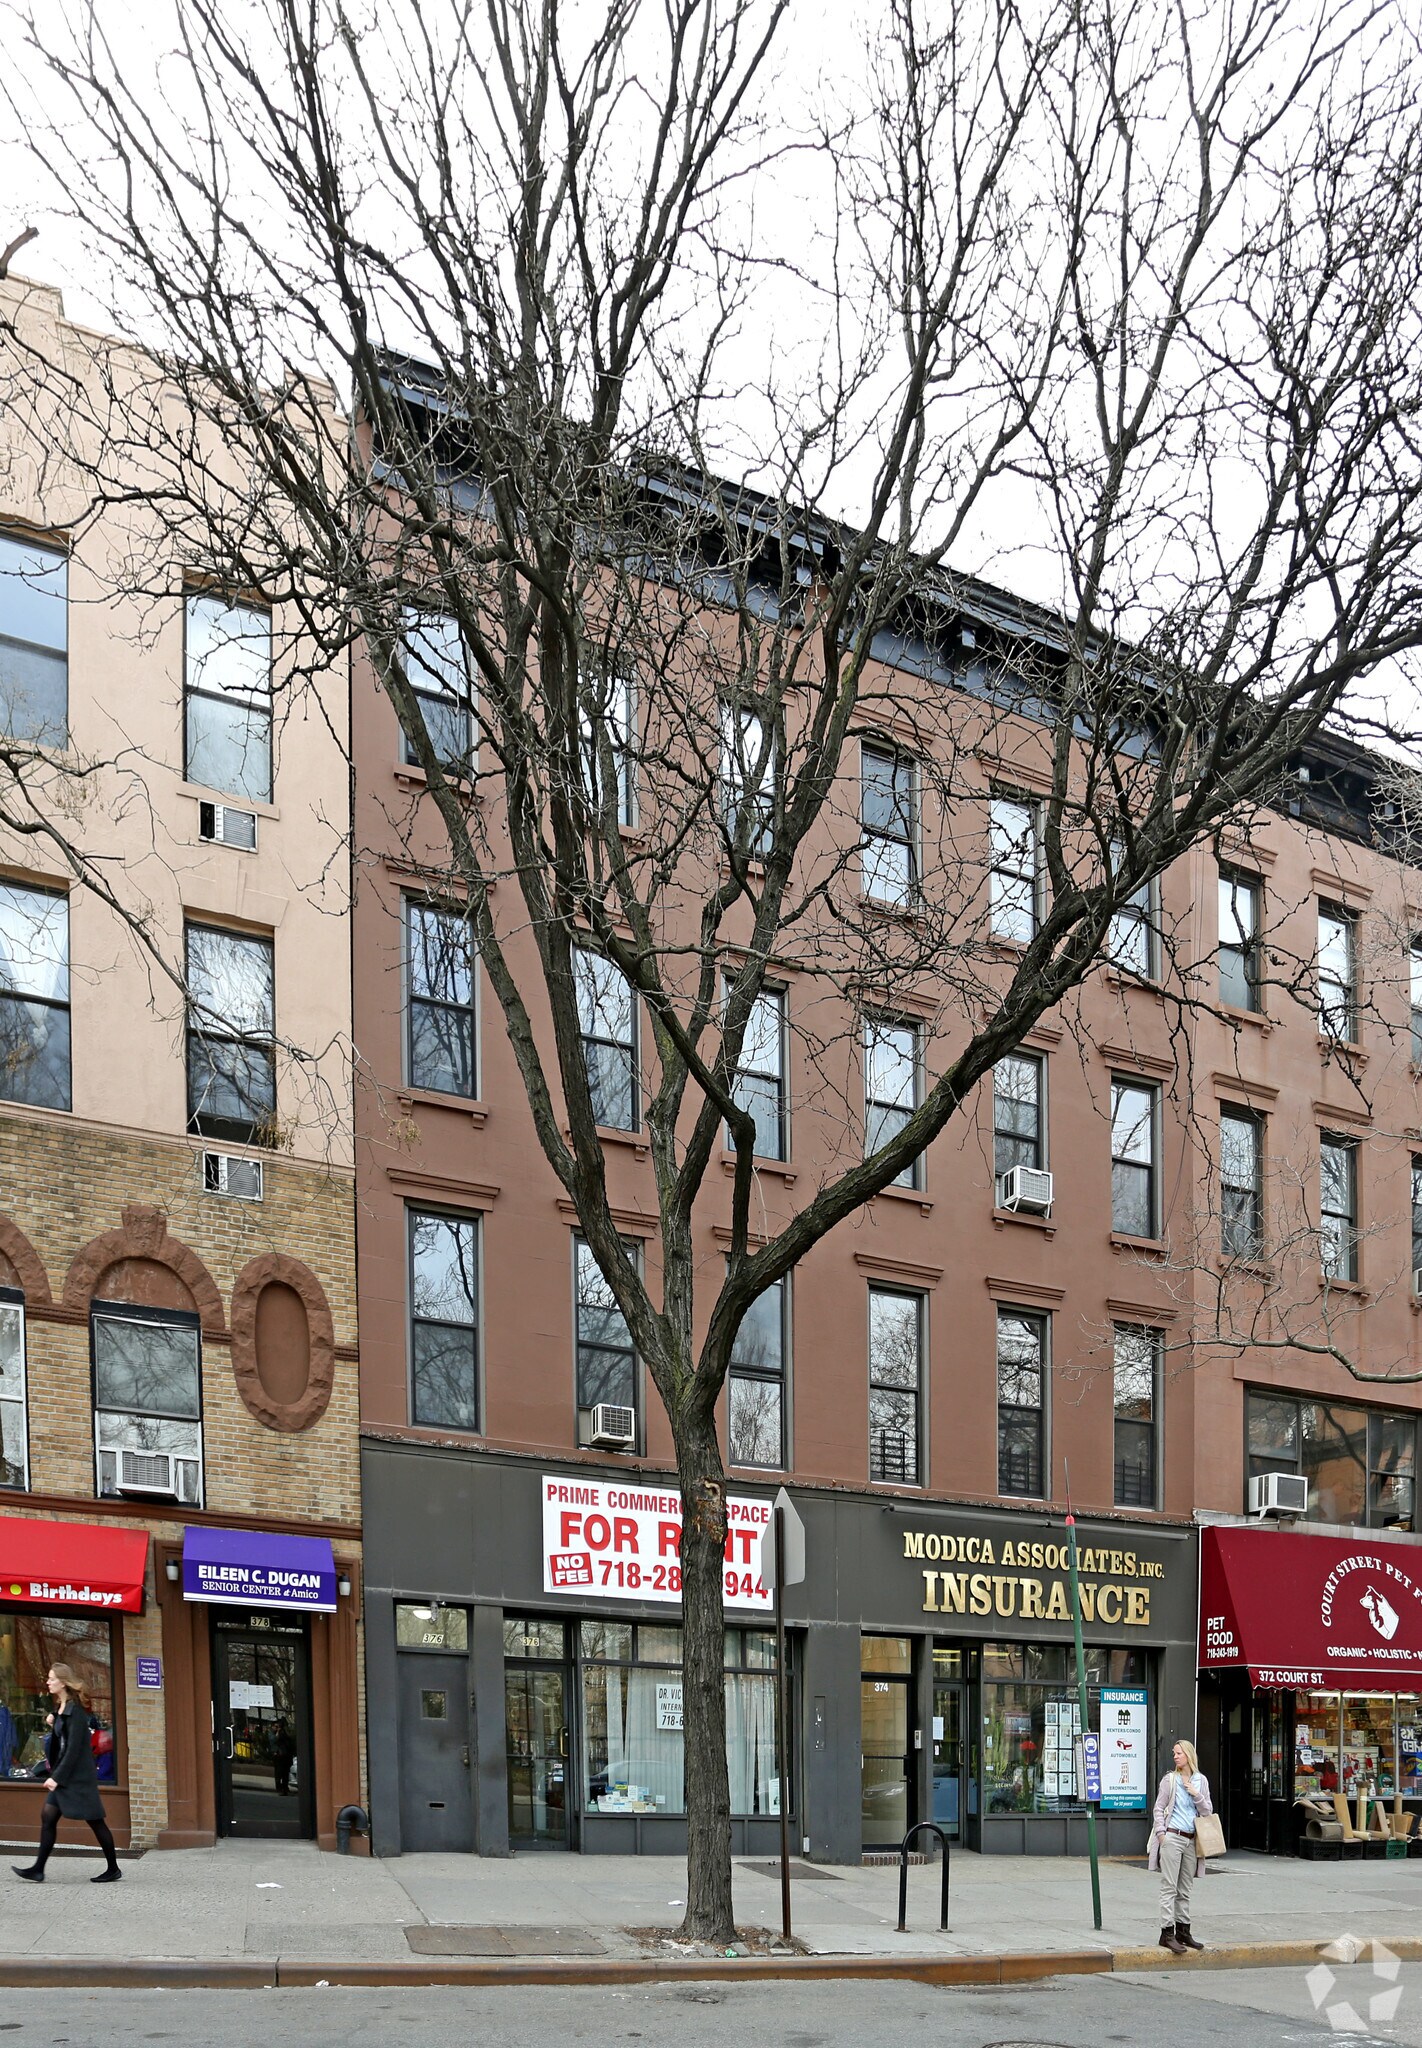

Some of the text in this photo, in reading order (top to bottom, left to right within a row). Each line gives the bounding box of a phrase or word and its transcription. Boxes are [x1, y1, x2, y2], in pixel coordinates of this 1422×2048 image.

[547, 1484, 599, 1506] PRIME
[608, 1491, 684, 1515] COMMER
[561, 1511, 757, 1564] FOR RT
[903, 1531, 996, 1565] MODICA
[1139, 1561, 1165, 1578] INC.
[556, 1556, 584, 1569] NO
[198, 1564, 321, 1588] EILEEN C. DUGAN
[555, 1569, 590, 1584] FEE
[598, 1560, 768, 1599] 718-28944
[29, 1582, 123, 1605] Birthdays
[202, 1580, 240, 1593] SENIOR
[241, 1584, 281, 1596] CENTER
[291, 1588, 319, 1599] Amico
[1321, 1556, 1412, 1627] COURT STREET PET
[922, 1570, 1151, 1626] INSURANCE
[251, 1617, 269, 1627] 378
[1207, 1616, 1225, 1631] PET
[424, 1634, 442, 1643] 376
[523, 1637, 539, 1646] 376
[1207, 1631, 1233, 1646] FOOD
[1327, 1646, 1368, 1657] ORGANIC
[1372, 1648, 1412, 1660] HOLISTIC
[1259, 1670, 1325, 1684] 372 COURT ST.
[659, 1688, 669, 1699] DR.
[874, 1682, 888, 1692] 374
[1103, 1691, 1144, 1702] INSURANCE
